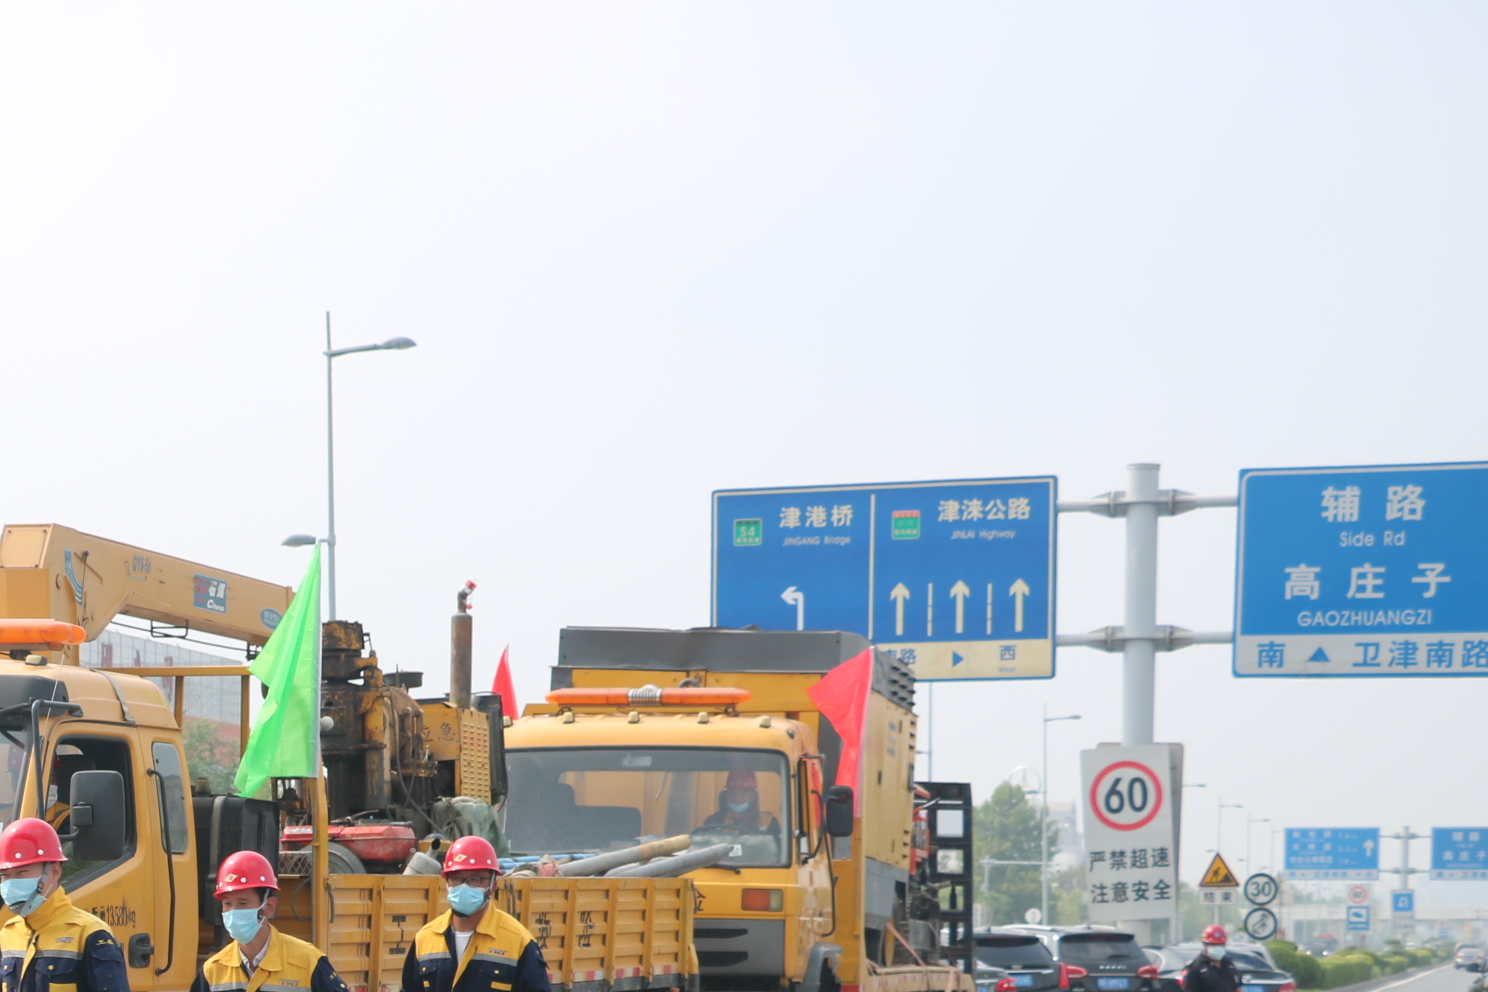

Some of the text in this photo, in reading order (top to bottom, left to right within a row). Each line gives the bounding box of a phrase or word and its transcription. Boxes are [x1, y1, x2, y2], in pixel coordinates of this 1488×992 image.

[938, 497, 1031, 522] 津涞公路
[1321, 485, 1426, 522] 辅路
[779, 504, 854, 529] 津港桥
[740, 526, 755, 537] S4
[783, 535, 851, 546] JINGANG Bridge
[979, 530, 1016, 540] Highway
[1339, 531, 1406, 547] Side Rd
[1284, 563, 1452, 600] 高庄子
[207, 599, 224, 611] China
[1297, 609, 1432, 627] GAOZHUANGZI
[1000, 645, 1016, 661] 西
[1257, 639, 1488, 669] 南 卫津南路
[1104, 776, 1148, 814] 60
[1089, 847, 1170, 872] 严禁超速
[1091, 879, 1172, 904] 注意安全
[1203, 891, 1233, 903] 结束
[1250, 881, 1272, 897] 30
